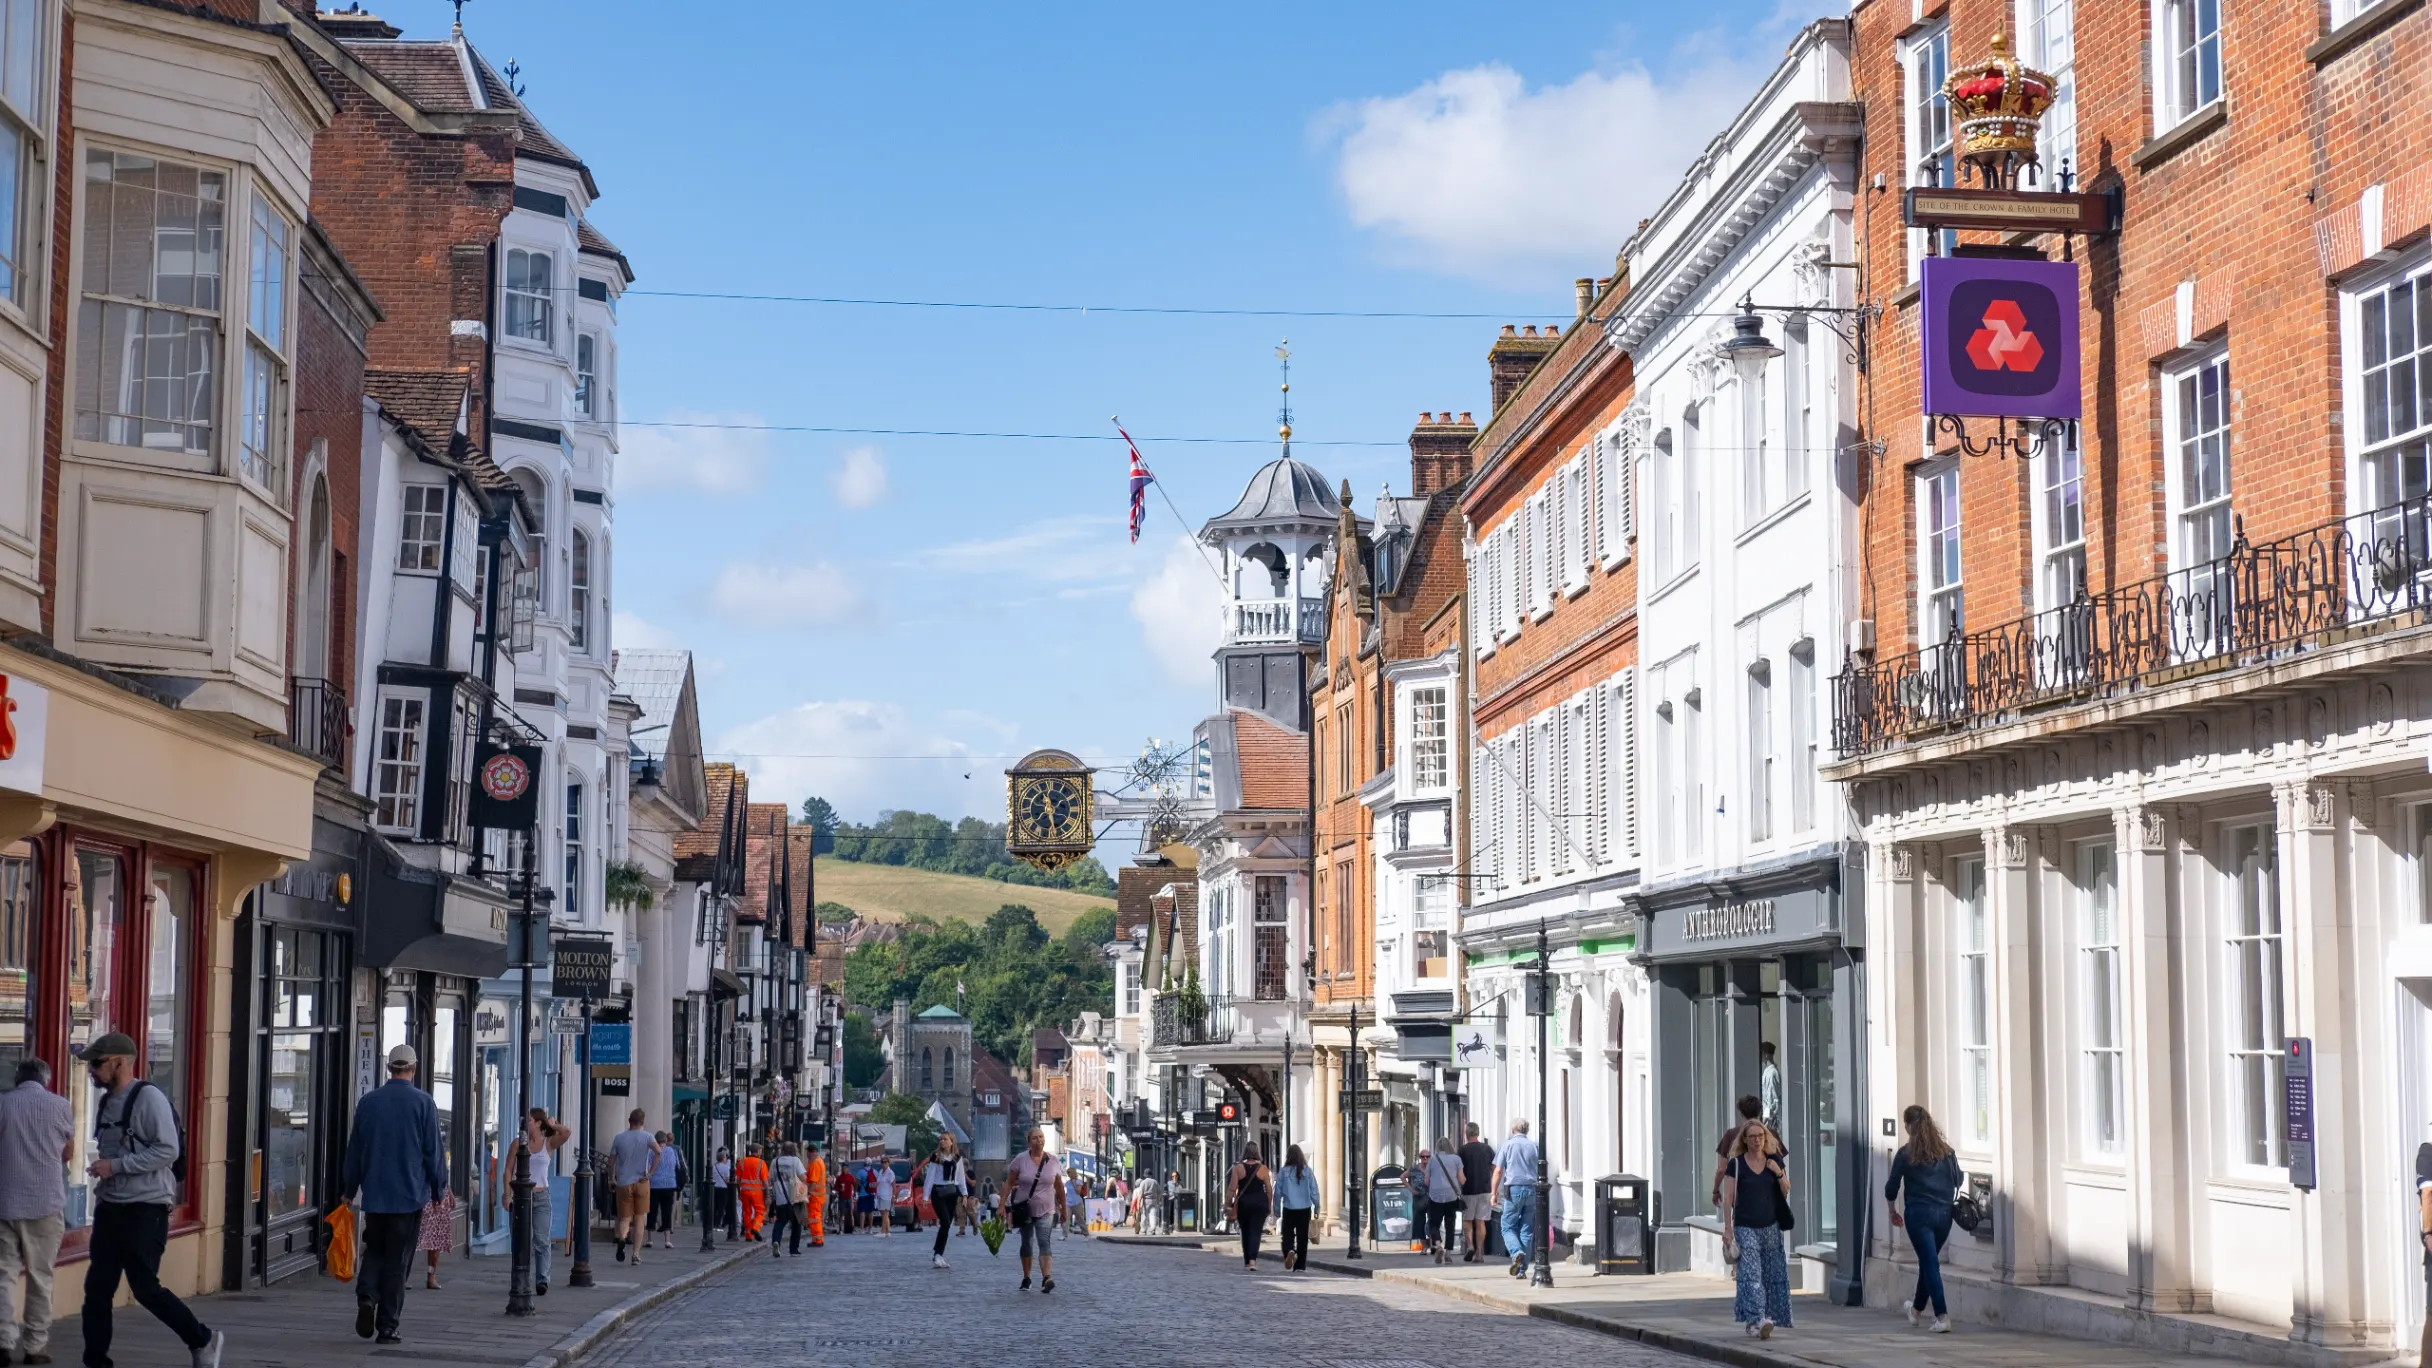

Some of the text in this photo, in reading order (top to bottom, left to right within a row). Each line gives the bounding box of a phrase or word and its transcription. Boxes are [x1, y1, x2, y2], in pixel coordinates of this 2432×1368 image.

[1918, 201, 2076, 215] SITE OF THE CROWN & FAMILY HOTEL
[1682, 900, 1772, 940] ANTHROPOLOGIE
[557, 951, 610, 966] MOLTON
[556, 965, 609, 980] BROWN
[604, 1078, 627, 1087] BOSS
